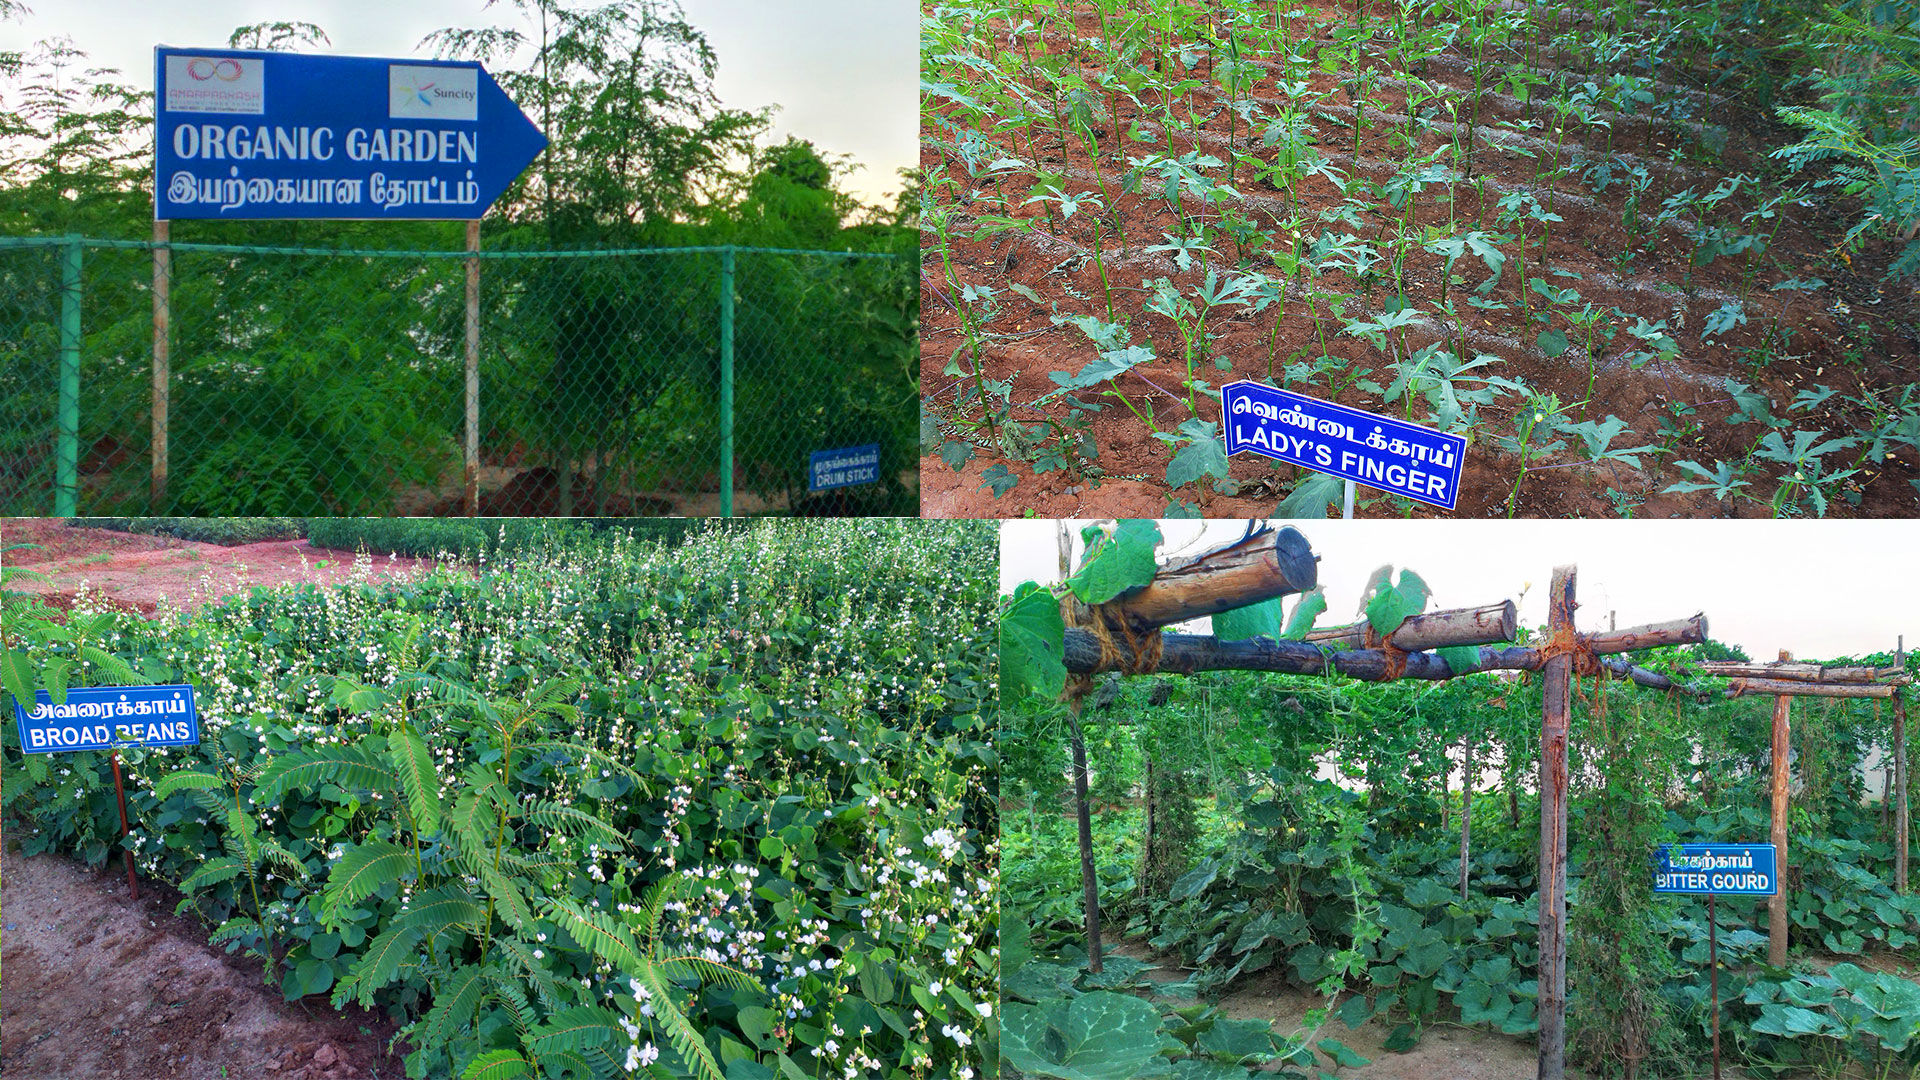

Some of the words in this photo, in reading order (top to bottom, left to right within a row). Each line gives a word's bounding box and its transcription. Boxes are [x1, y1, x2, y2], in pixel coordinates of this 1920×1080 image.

[433, 88, 475, 102] Suncity
[173, 123, 334, 161] ORGANIC
[345, 127, 478, 163] GARDEN
[167, 165, 363, 214] இயற்கையான
[369, 169, 479, 212] தோட்டம்
[1232, 395, 1455, 468] வெண்டைக்காய்
[1235, 424, 1333, 466] LADY'S
[1341, 450, 1447, 499] FINGER
[816, 471, 845, 488] DRUM
[847, 467, 874, 483] STICK
[26, 691, 186, 720] அவரைக்காய்
[30, 725, 110, 747] BROAD
[115, 721, 190, 742] BEANS
[1656, 873, 1709, 889] BITTER
[1712, 873, 1769, 890] GOURD
